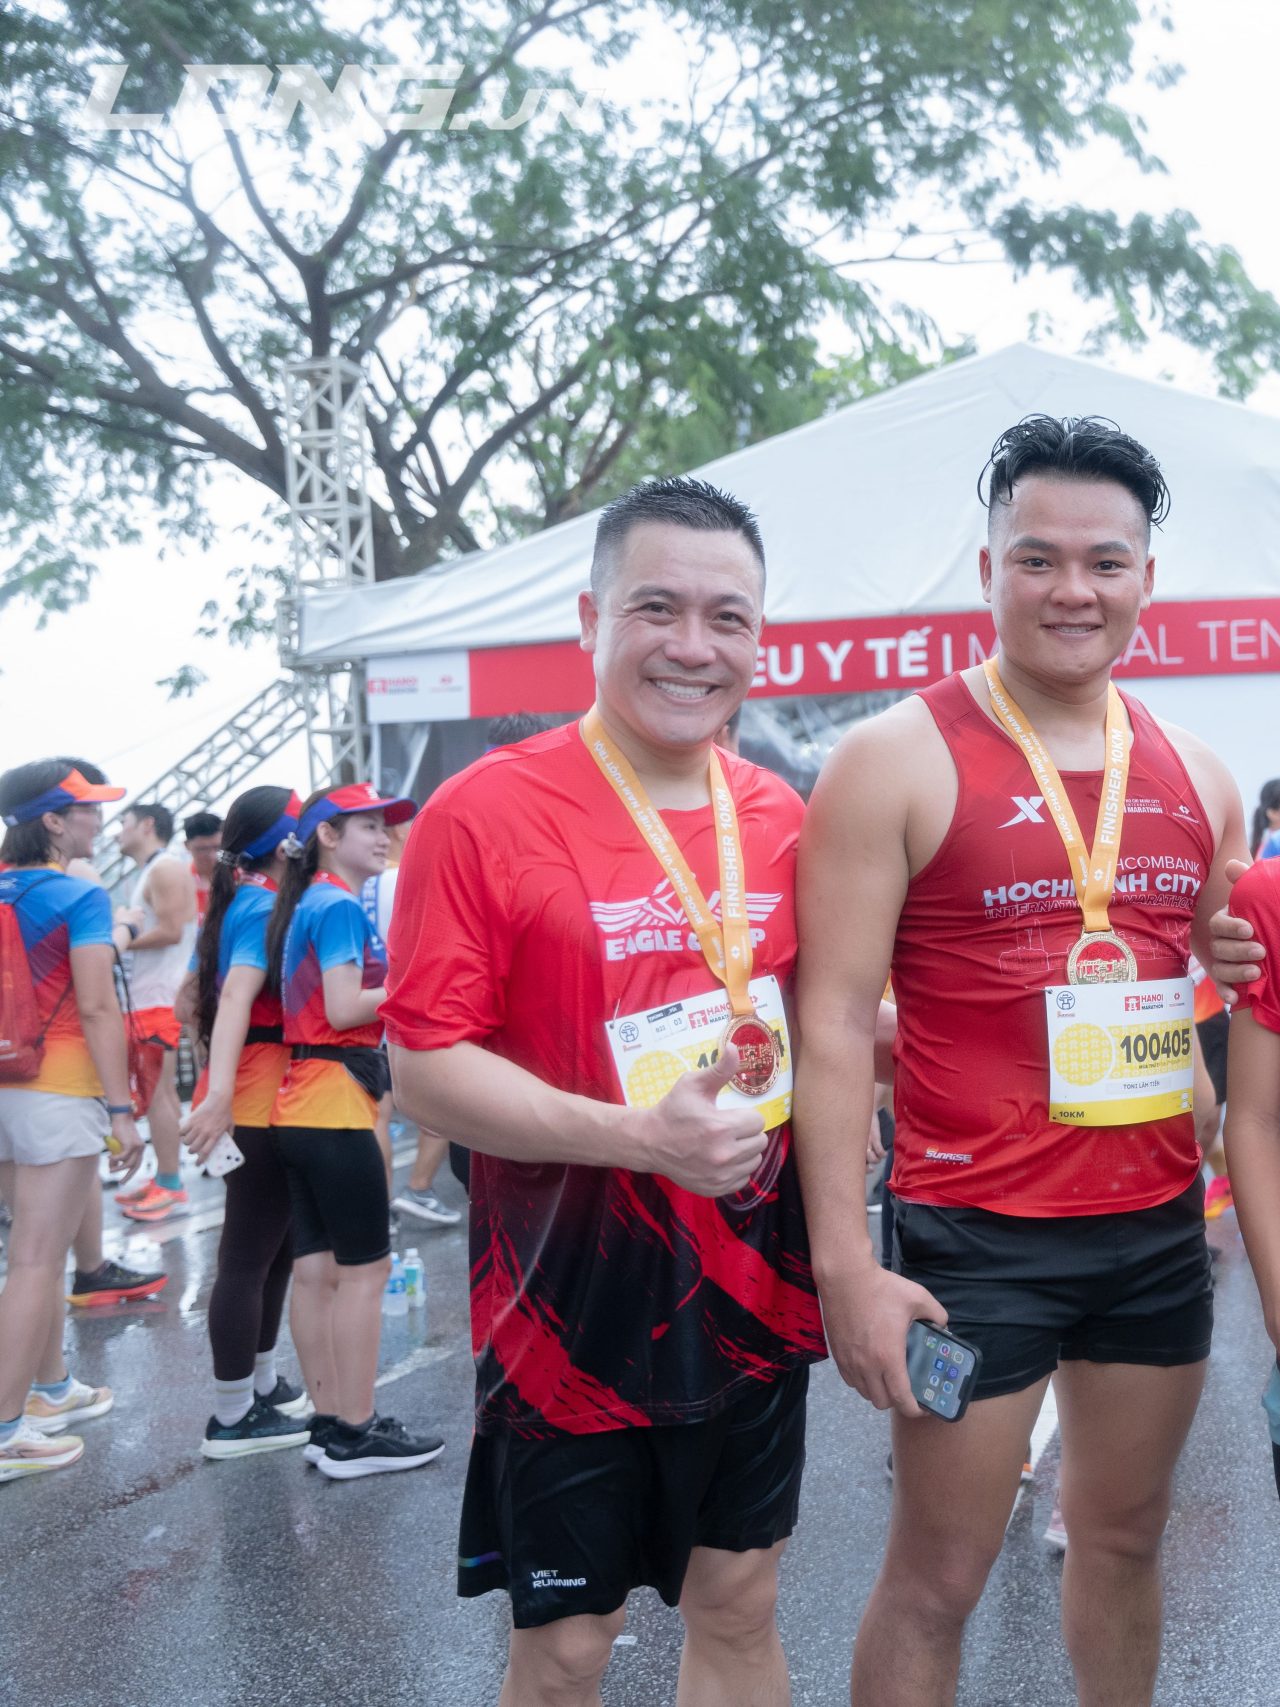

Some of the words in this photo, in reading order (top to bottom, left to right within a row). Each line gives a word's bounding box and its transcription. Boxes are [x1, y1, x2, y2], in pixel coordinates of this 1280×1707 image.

[817, 640, 853, 682] Y
[864, 626, 933, 679] TẾ
[1004, 713, 1021, 735] NAM
[1111, 728, 1124, 766] 10KM
[715, 788, 733, 830] 10KM
[1100, 768, 1124, 845] FINISHER
[721, 835, 742, 920] FINISHER
[1155, 873, 1201, 897] CITY
[1122, 894, 1194, 911] MARATHON
[606, 928, 683, 961] EAGLE
[706, 1002, 730, 1016] HANO
[1141, 994, 1164, 1003] HANOI
[1120, 1028, 1191, 1064] 100405
[1059, 1111, 1085, 1119] 10KM
[531, 1569, 558, 1579] VIET
[532, 1577, 587, 1589] RUNNING
